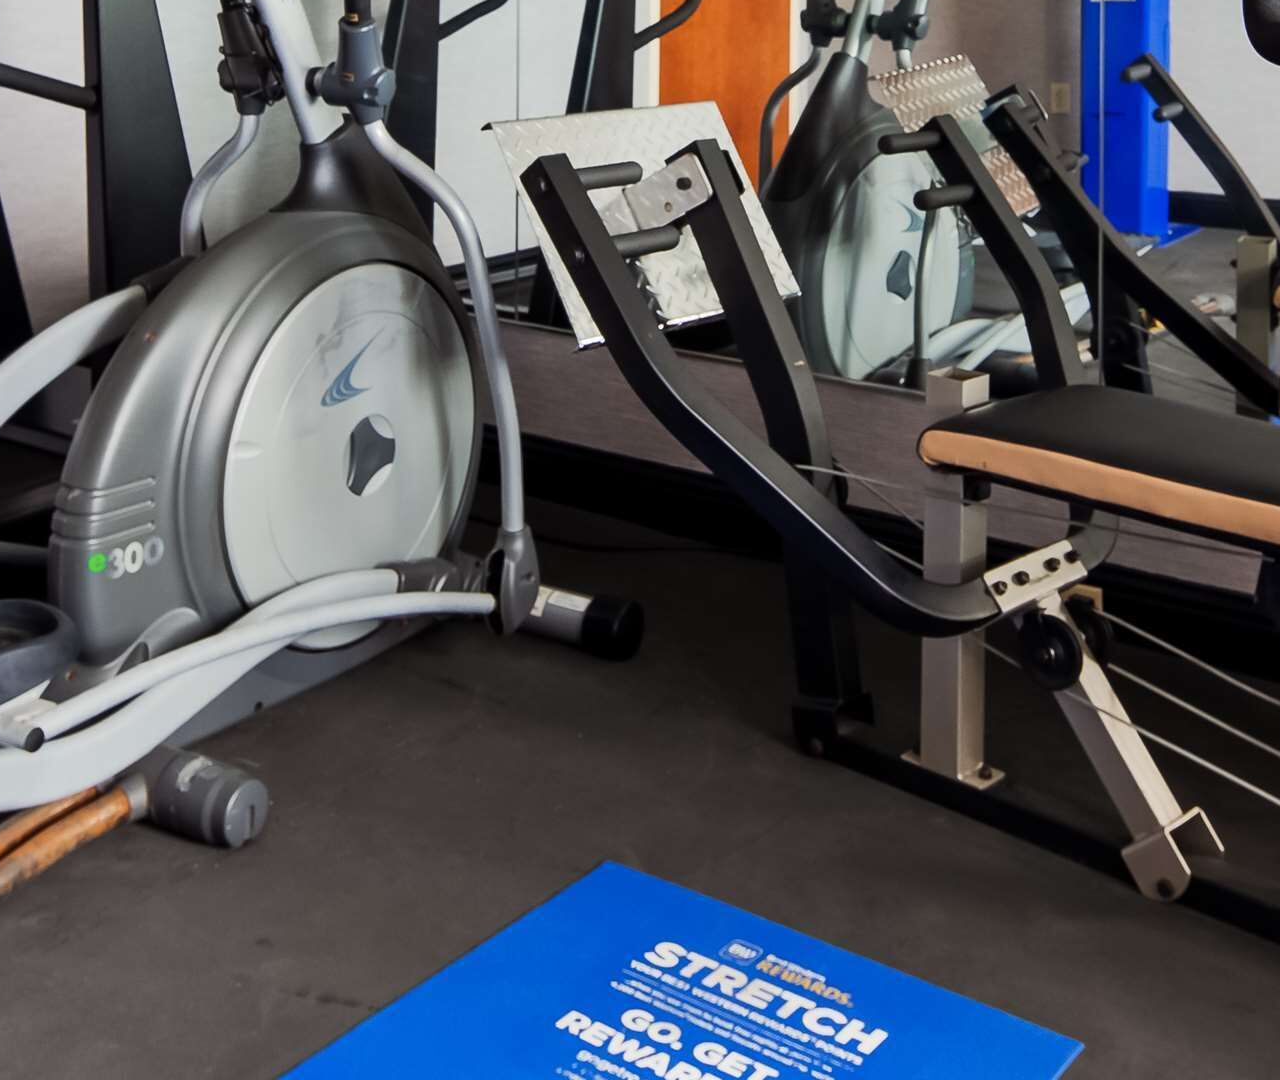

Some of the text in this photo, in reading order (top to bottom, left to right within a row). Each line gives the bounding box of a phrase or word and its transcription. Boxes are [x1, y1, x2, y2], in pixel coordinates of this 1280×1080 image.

[87, 536, 165, 580] e300
[644, 941, 889, 1056] STRETCH
[692, 1041, 781, 1080] GET
